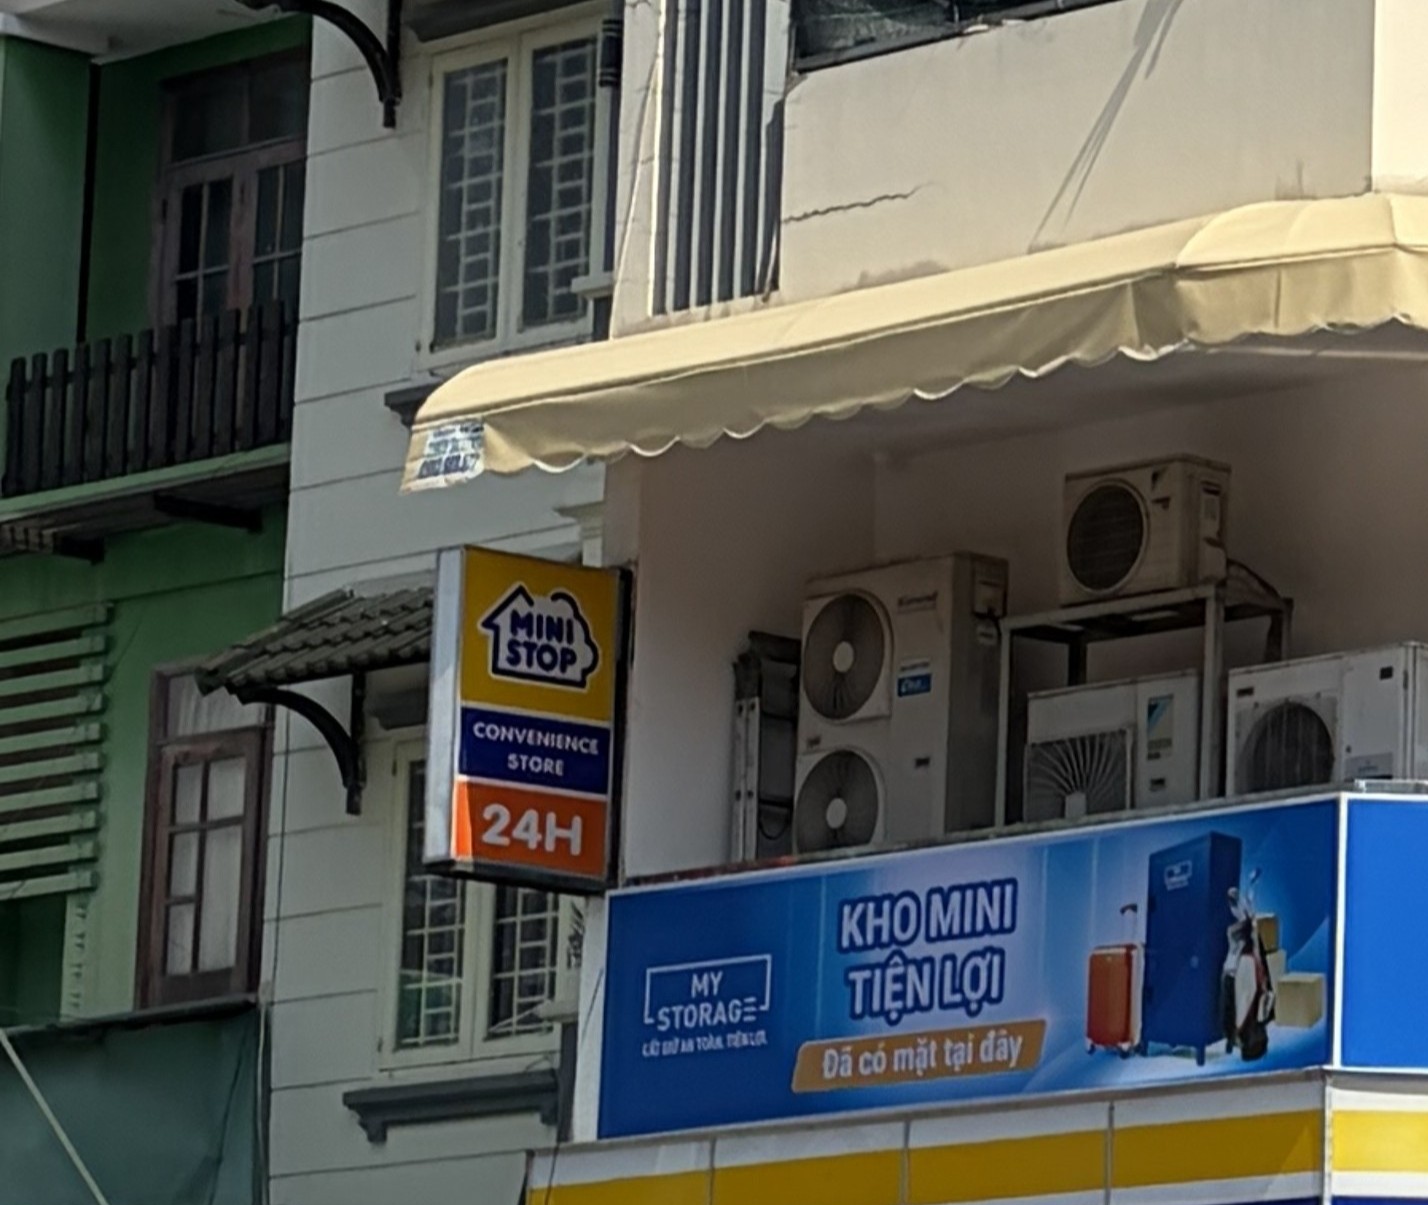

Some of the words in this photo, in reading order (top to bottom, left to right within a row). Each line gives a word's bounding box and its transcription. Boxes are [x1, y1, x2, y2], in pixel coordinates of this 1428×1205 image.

[510, 609, 574, 645] MINI
[506, 643, 577, 674] STOP
[472, 721, 599, 755] CONVENIENCE
[507, 753, 565, 776] STORE
[481, 803, 583, 857] 24H
[840, 895, 919, 950] KHO
[927, 882, 1014, 939] MINI
[691, 970, 723, 998] MY
[848, 954, 932, 1021] TIỆN
[942, 951, 1001, 1011] LỢI
[657, 997, 757, 1031] STORAGE
[822, 1044, 853, 1079] Đã
[859, 1042, 887, 1075] có
[893, 1037, 937, 1077] mặt
[944, 1033, 974, 1072] tại
[979, 1028, 1024, 1068] đây
